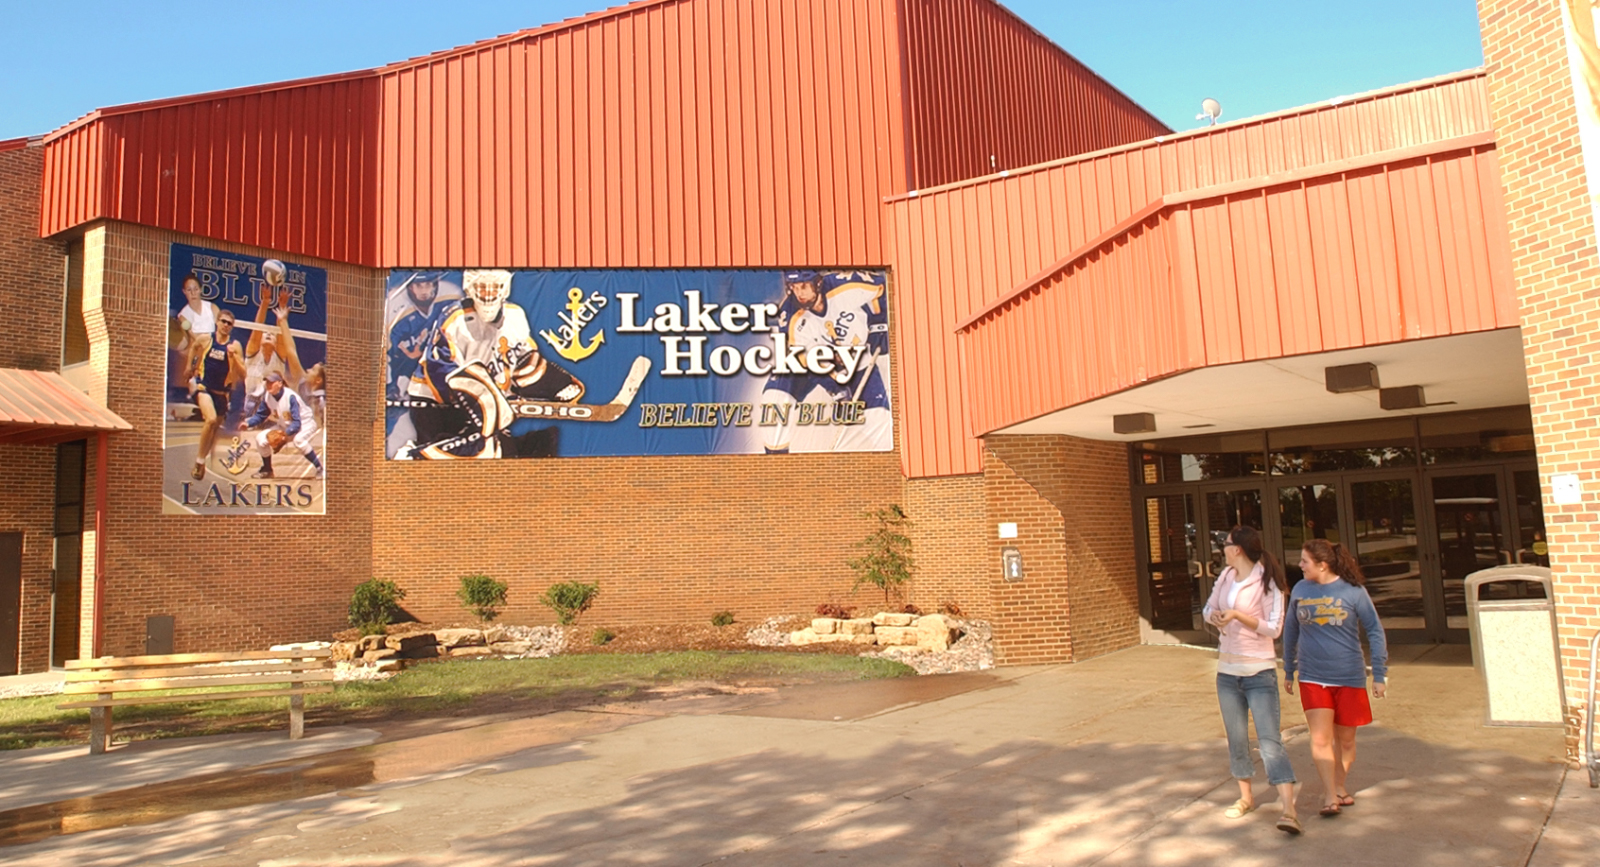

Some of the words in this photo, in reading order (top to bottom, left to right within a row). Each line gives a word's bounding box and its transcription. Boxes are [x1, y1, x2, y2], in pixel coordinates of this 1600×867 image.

[192, 253, 257, 275] BELIEVE
[288, 269, 306, 285] IN
[192, 268, 307, 314] BLUE
[616, 290, 778, 332] Laker
[538, 290, 608, 350] Lakers
[660, 333, 866, 384] Hockey
[638, 402, 753, 427] BELIEVE
[758, 402, 791, 427] IN
[796, 401, 866, 426] BLUE
[181, 480, 313, 508] LAKERS
